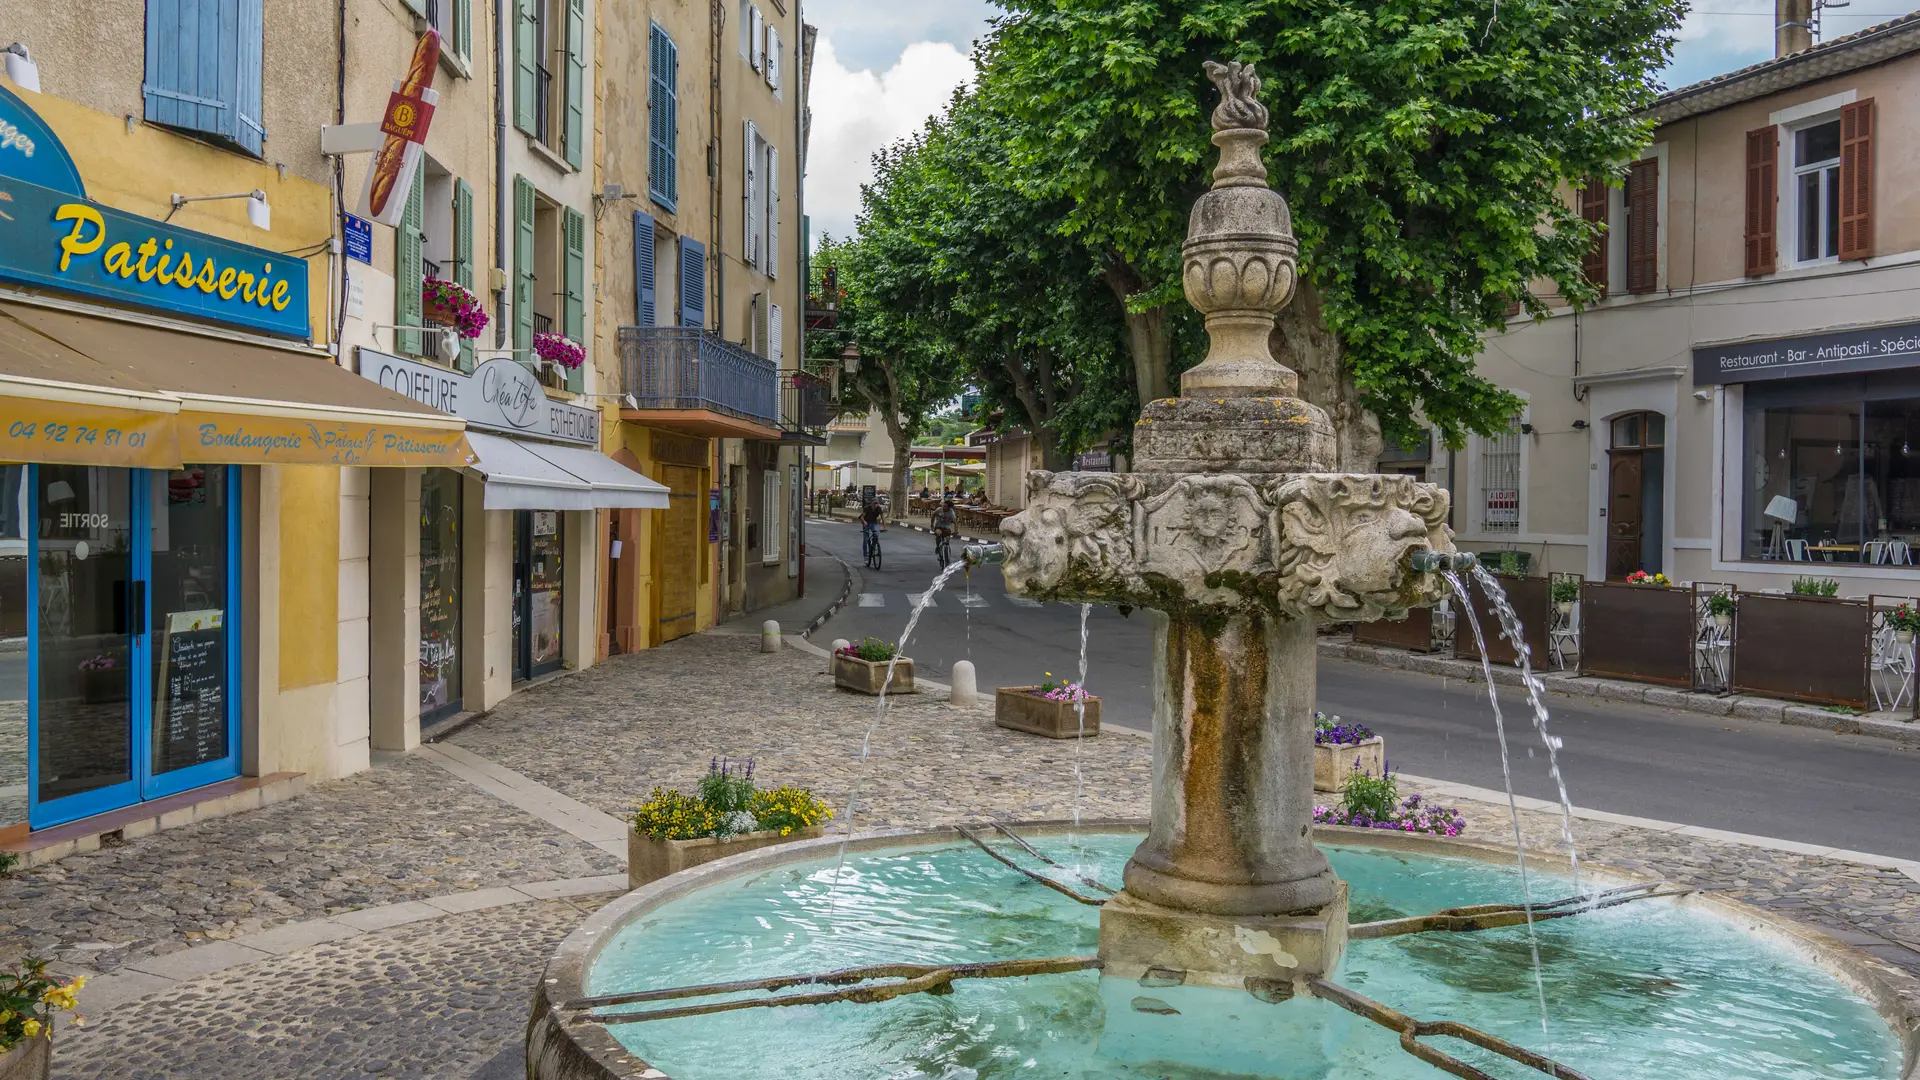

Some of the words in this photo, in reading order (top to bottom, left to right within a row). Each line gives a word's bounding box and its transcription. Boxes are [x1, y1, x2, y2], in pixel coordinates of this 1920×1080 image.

[384, 122, 414, 138] BAGUÉPI
[398, 106, 410, 123] B
[55, 203, 291, 311] Patisserie
[1720, 351, 1778, 368] Restaurant
[1787, 349, 1806, 362] Bar
[1816, 340, 1870, 359] Antipasti
[1880, 336, 1920, 354] Spéci
[379, 364, 458, 414] COIFFURE
[9, 421, 37, 440] 04
[44, 423, 69, 442] 92
[75, 426, 98, 444] 74
[104, 429, 122, 446] 81
[128, 432, 147, 448] 01
[199, 423, 302, 455] Boulangerie
[324, 431, 363, 449] Palais
[383, 433, 448, 455] Pâtisserie
[550, 406, 595, 440] ESTHÉTIQUE
